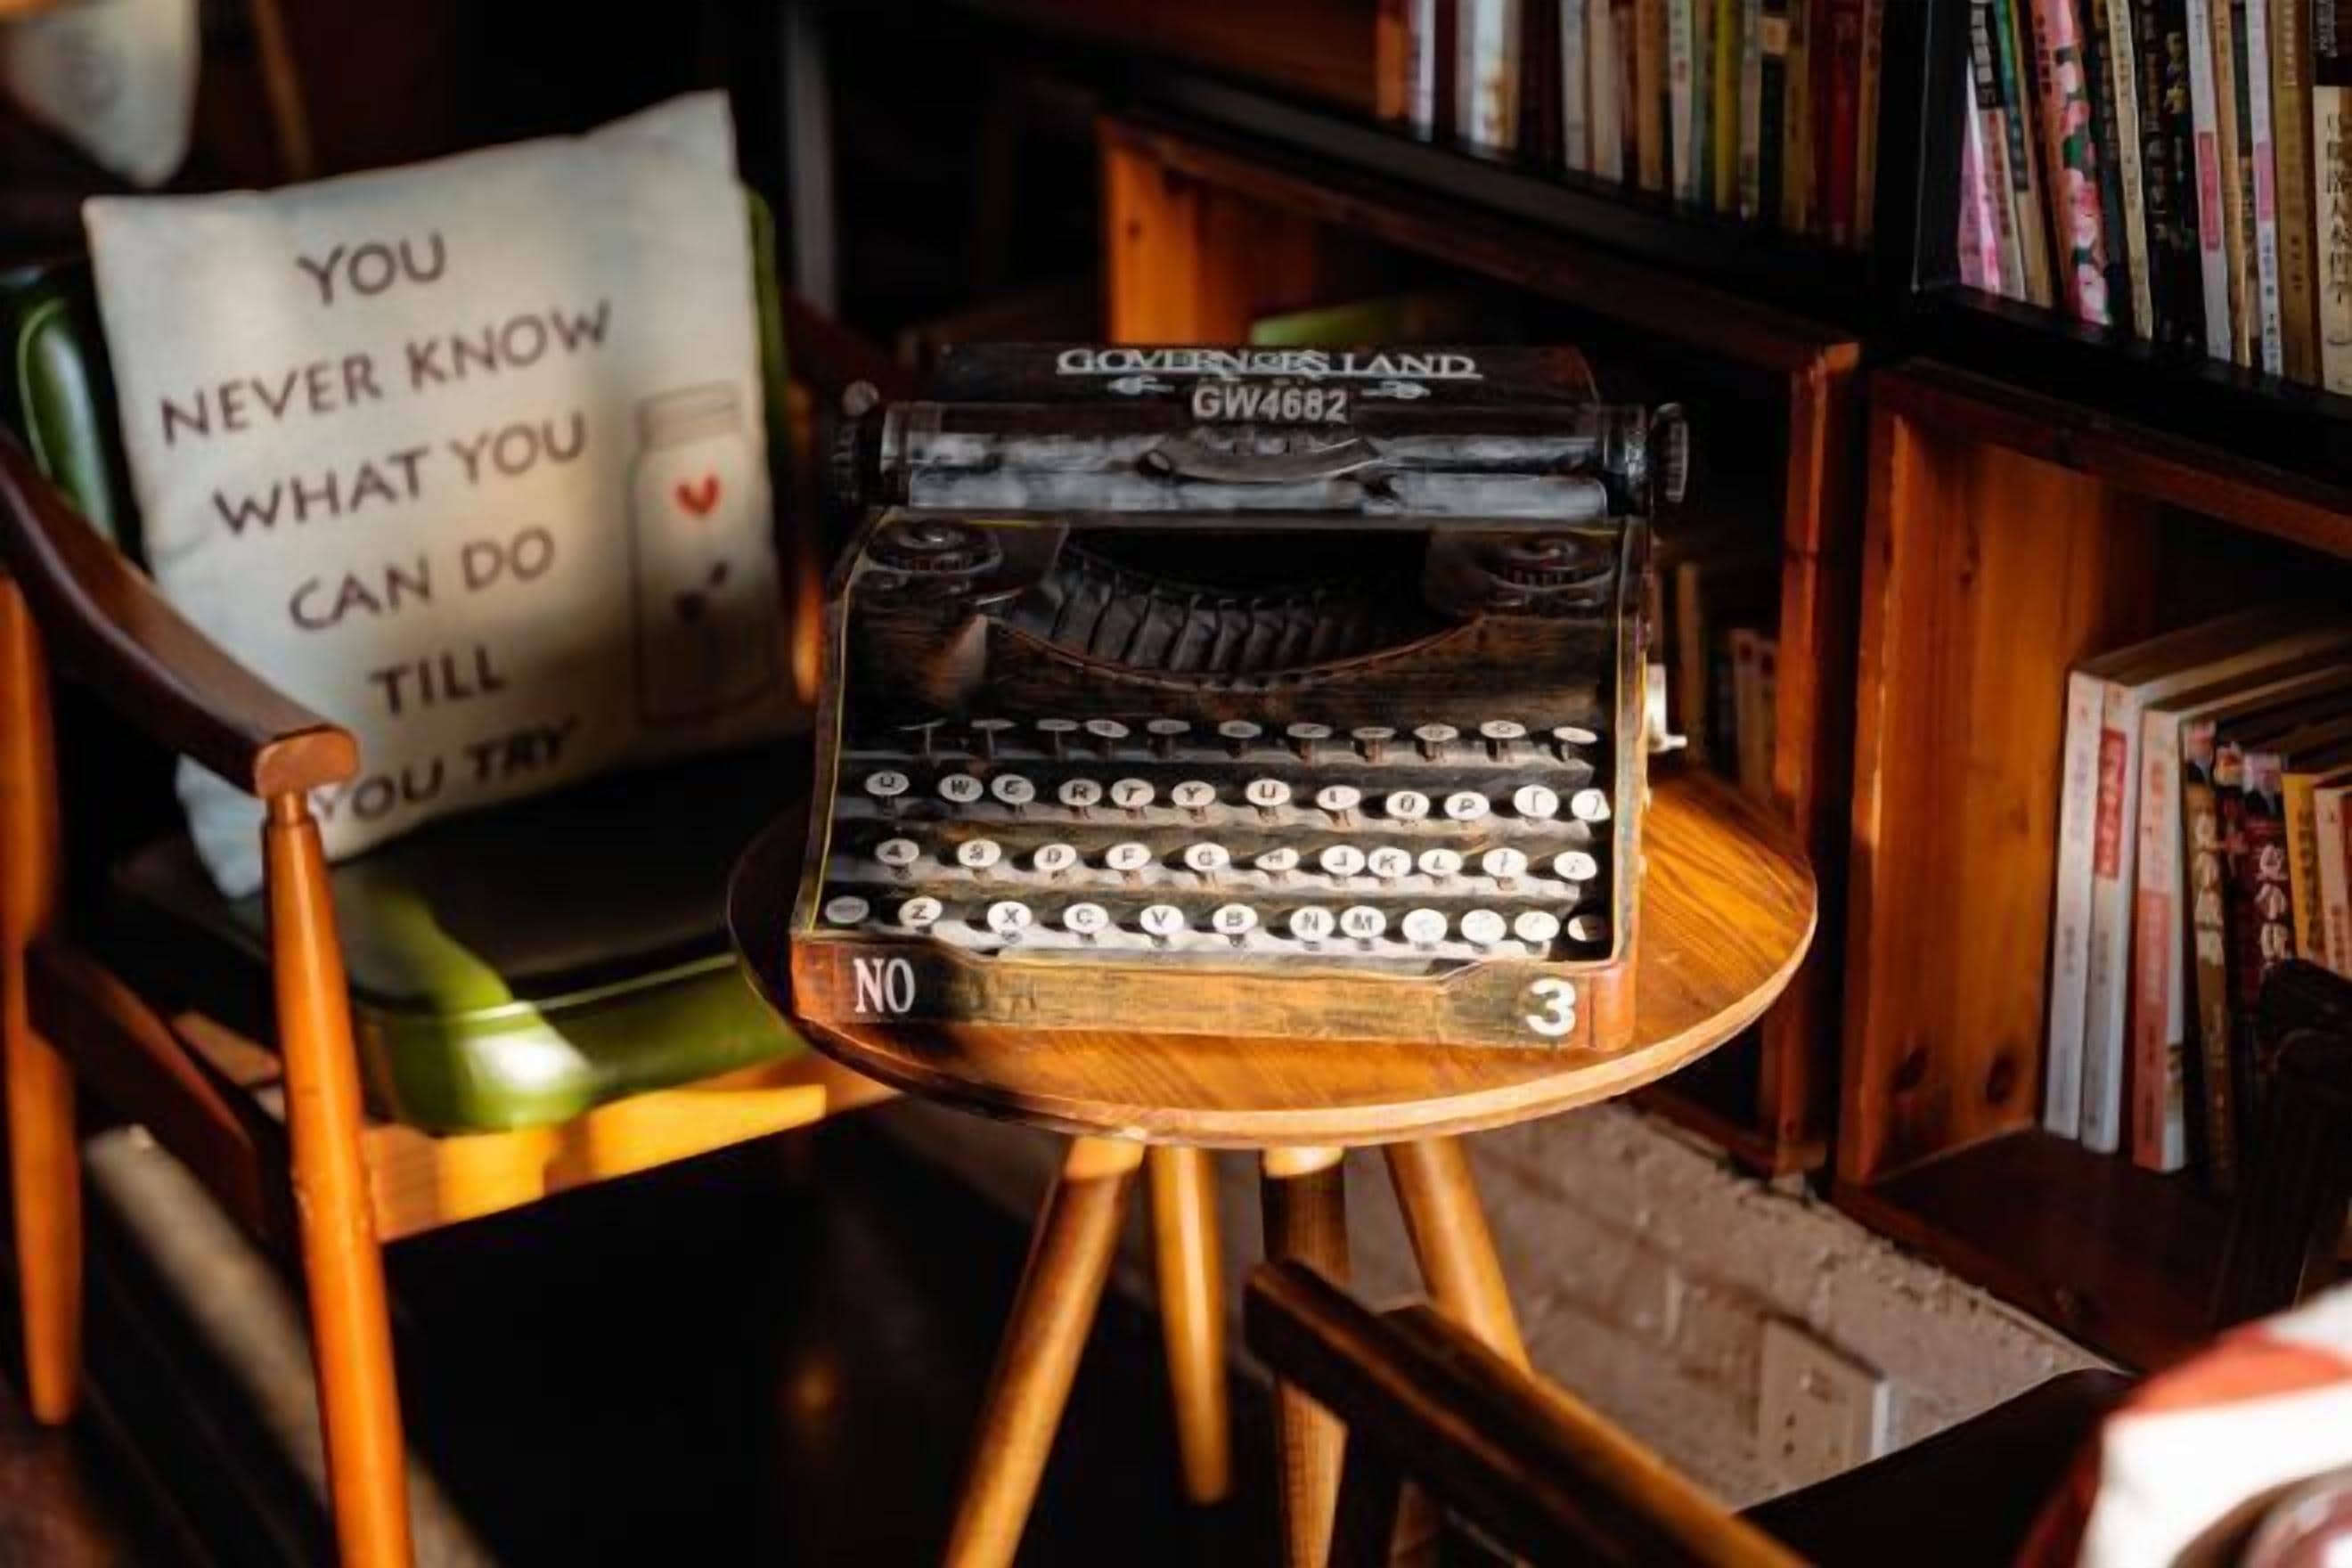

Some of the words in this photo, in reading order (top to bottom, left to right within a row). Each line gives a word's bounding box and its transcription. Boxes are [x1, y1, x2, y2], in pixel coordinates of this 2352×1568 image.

[297, 233, 447, 306] YOU
[159, 349, 382, 445] NEVER
[405, 299, 612, 387] KNOW
[1193, 384, 1348, 423] GW4682
[211, 447, 429, 535] WHAT
[449, 411, 586, 486] YOU
[288, 558, 432, 632] CAN
[461, 527, 555, 593] DO
[369, 645, 508, 715] TILL
[463, 715, 577, 780] TRY
[853, 958, 916, 1014] NO
[1526, 978, 1576, 1036] 3
